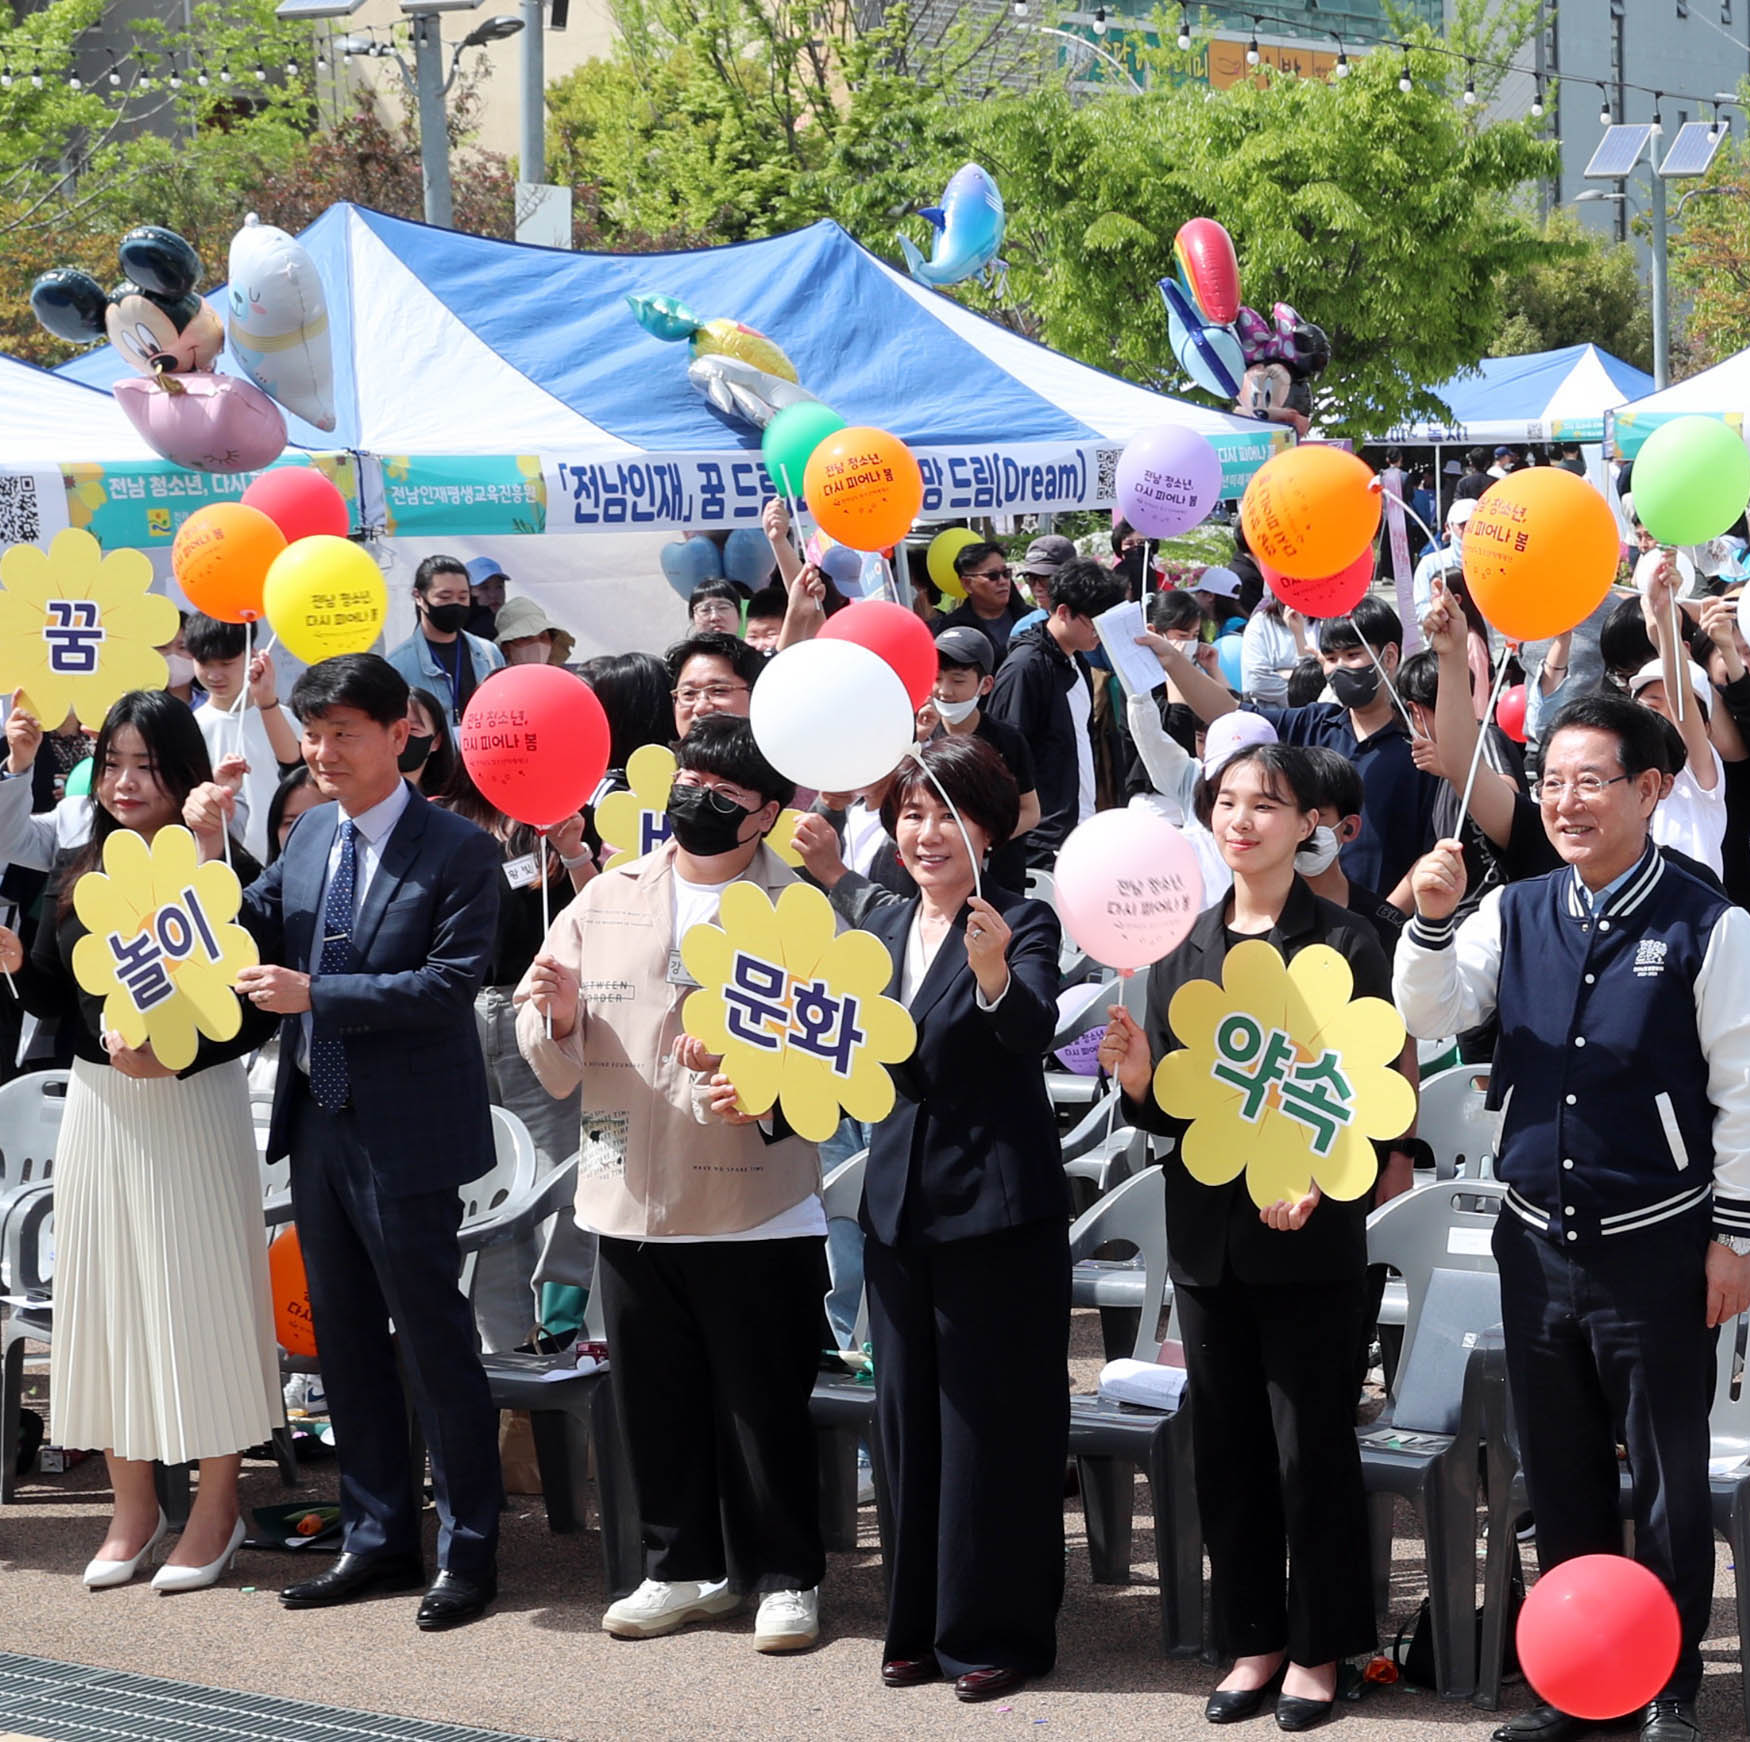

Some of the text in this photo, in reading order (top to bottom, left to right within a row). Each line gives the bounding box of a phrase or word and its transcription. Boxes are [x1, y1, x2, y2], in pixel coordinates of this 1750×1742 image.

[824, 452, 884, 478] 전남 청소년,
[108, 474, 246, 499] 전남 청소년, 다시
[391, 484, 537, 505] 전남인재평생교육진흥원
[558, 463, 693, 524] 「전남인재」
[696, 463, 726, 520] 꿈
[948, 449, 1087, 509] 드림(Dream)
[823, 479, 845, 496] 다시
[847, 473, 882, 490] 피어나
[884, 468, 895, 483] 봄
[1155, 490, 1186, 506] 피어나
[1474, 520, 1511, 543] 피어나
[1514, 531, 1529, 553] 봄
[45, 603, 104, 673] 꿈
[480, 733, 520, 751] 피어나
[525, 732, 538, 752] 봄
[110, 888, 219, 1013] 놀이
[724, 954, 864, 1075] 문화
[1213, 1015, 1355, 1154] 약속
